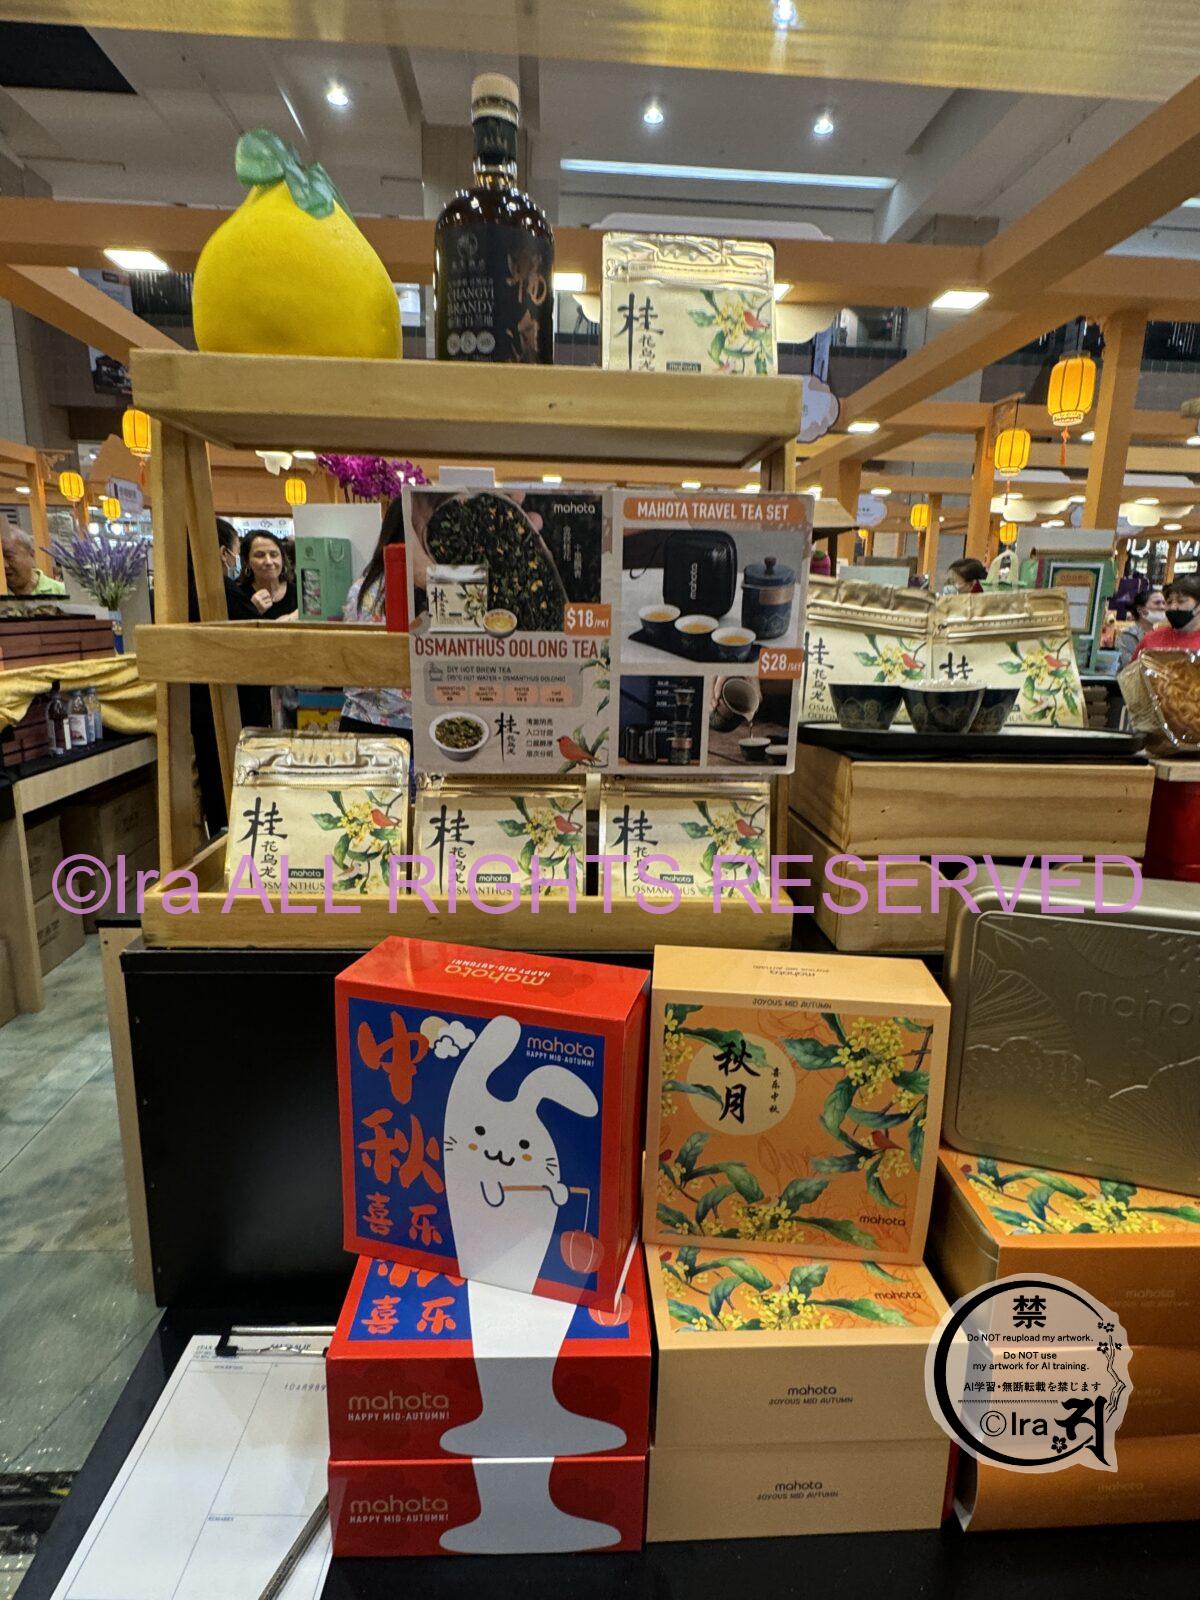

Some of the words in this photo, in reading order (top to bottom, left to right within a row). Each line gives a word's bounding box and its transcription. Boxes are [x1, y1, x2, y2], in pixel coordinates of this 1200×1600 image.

[614, 292, 664, 370] 桂
[553, 502, 596, 514] mahota
[637, 502, 689, 519] MAHOTA
[692, 503, 737, 520] TRAVEL
[741, 503, 763, 520] TEA
[766, 504, 789, 521] SET
[415, 637, 505, 657] OSMANTHUS
[509, 639, 567, 658] OOLONG
[572, 640, 598, 658] TEA
[494, 712, 520, 764] 桂
[237, 797, 288, 889] 桂
[426, 805, 474, 895] 桂
[610, 805, 658, 897] 桂
[259, 840, 278, 879] 花乌龙
[290, 869, 321, 877] mahota
[478, 874, 508, 882] mahota
[444, 965, 546, 986] mahota
[518, 967, 551, 978] HAPPY
[752, 998, 782, 1007] JOYOUS
[784, 1000, 798, 1008] MID
[800, 1001, 832, 1009] AUTUMN
[526, 1051, 547, 1060] HAPPY
[527, 1036, 595, 1058] mahota
[713, 1040, 761, 1124] 秋月
[357, 1010, 445, 1194] 中秋
[362, 1192, 443, 1246] 喜乐
[859, 1214, 906, 1227] mahota
[874, 1290, 921, 1300] mahota
[361, 1295, 457, 1335] 喜乐
[787, 1384, 837, 1396] mahota
[349, 1390, 449, 1410] mahota
[820, 1396, 853, 1404] AUTUMN
[348, 1413, 379, 1421] HAPPY
[774, 1481, 823, 1491] mahota
[350, 1495, 448, 1513] mahota
[350, 1515, 380, 1523] HAPPY
